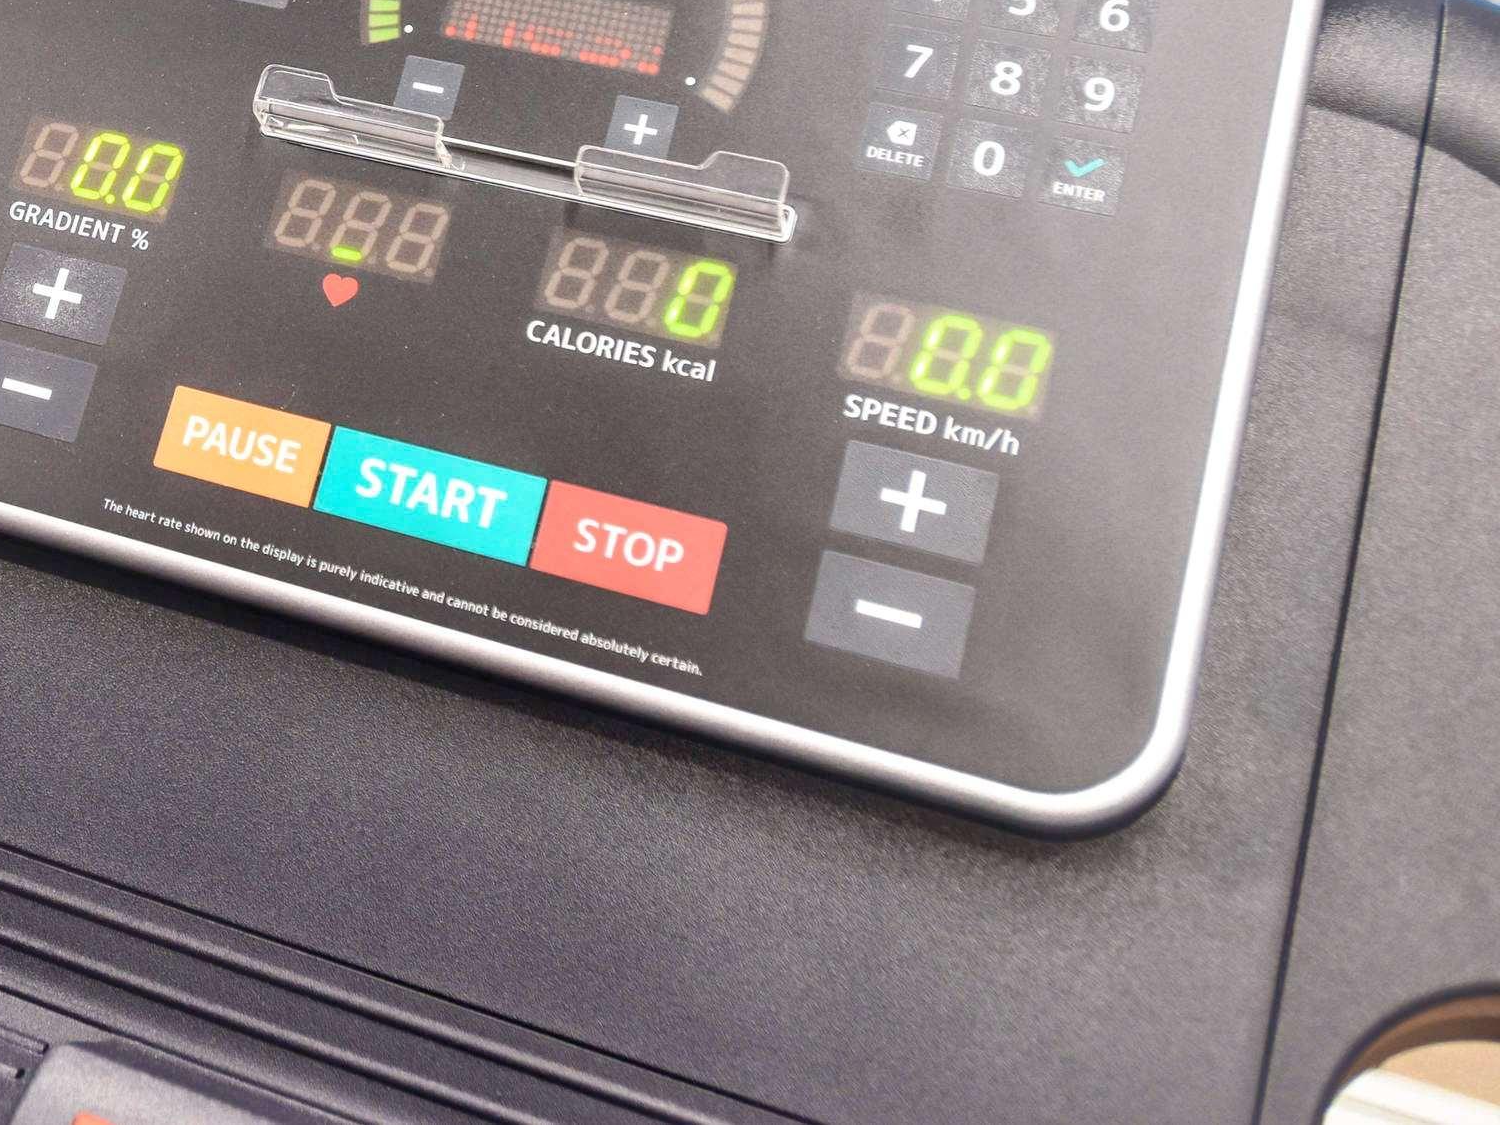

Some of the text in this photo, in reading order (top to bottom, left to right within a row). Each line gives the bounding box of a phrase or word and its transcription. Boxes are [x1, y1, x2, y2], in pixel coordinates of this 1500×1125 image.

[902, 44, 934, 81] 7
[988, 60, 1022, 98] 8
[1083, 74, 1116, 113] 9
[69, 130, 185, 213] 0.0
[865, 144, 925, 168] DELETE
[971, 139, 1005, 177] 0
[1051, 181, 1106, 203] ENTER
[7, 200, 150, 250] GRADIENT %
[663, 257, 736, 339] 0
[526, 320, 718, 383] CALORIES kcal
[908, 312, 1052, 411] 0.0
[181, 414, 303, 475] PAUSE
[843, 393, 1021, 458] SPEED km/h
[355, 456, 509, 530] START
[573, 516, 685, 574] STOP
[103, 497, 702, 676] The heart rate shown on the display is purely indicative and cannot be considered absolutely certain.
